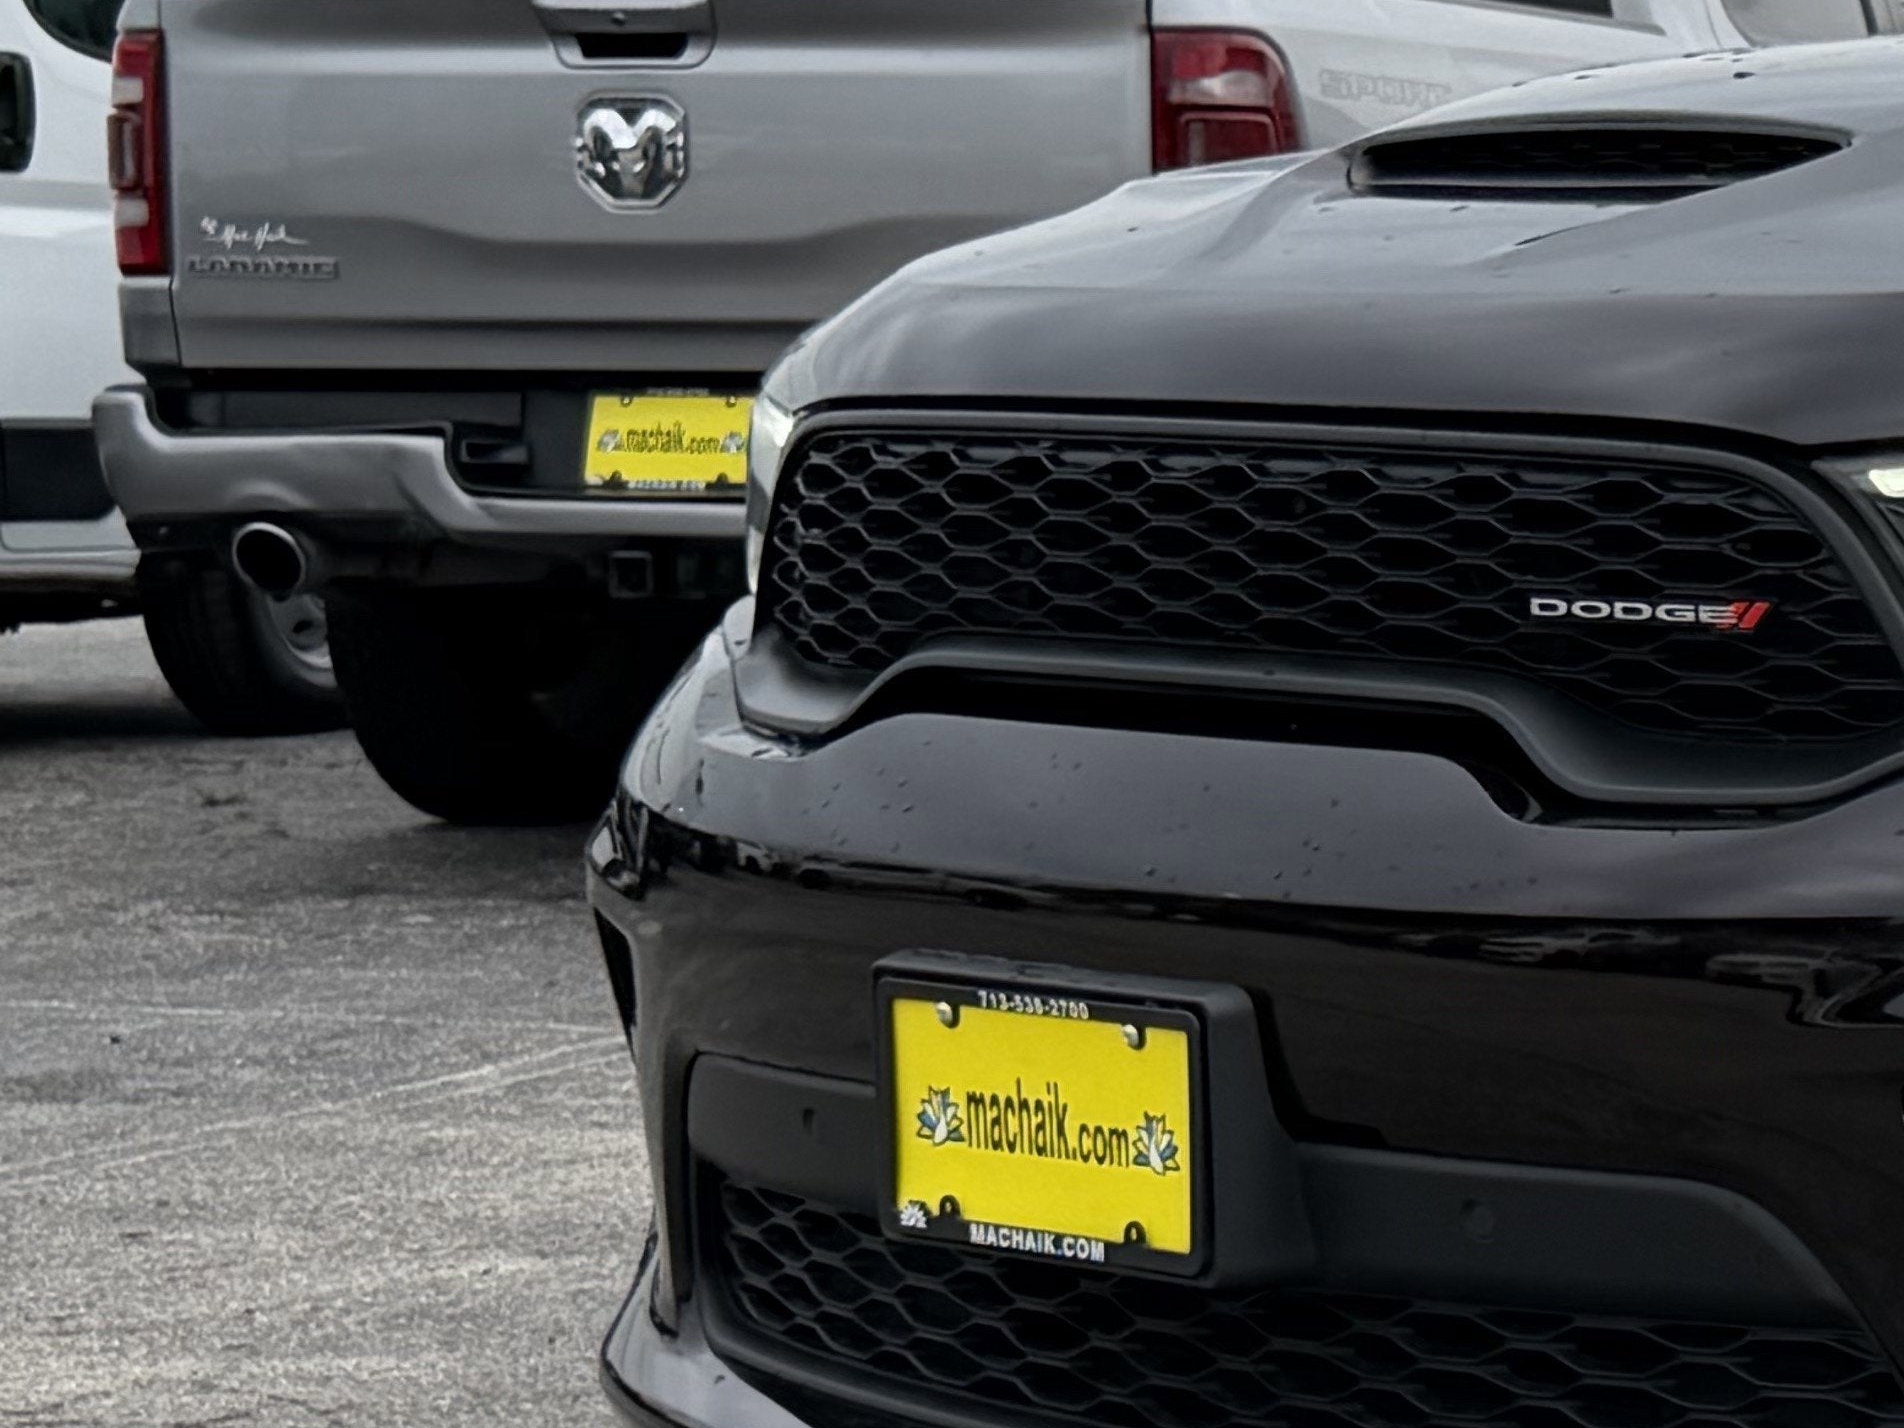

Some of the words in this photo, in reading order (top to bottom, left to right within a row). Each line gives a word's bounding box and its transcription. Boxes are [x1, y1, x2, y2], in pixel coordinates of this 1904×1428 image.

[1529, 597, 1738, 625] DODGE
[966, 1077, 1131, 1170] machaik.com
[970, 1223, 1106, 1263] MACHAIK.COM
